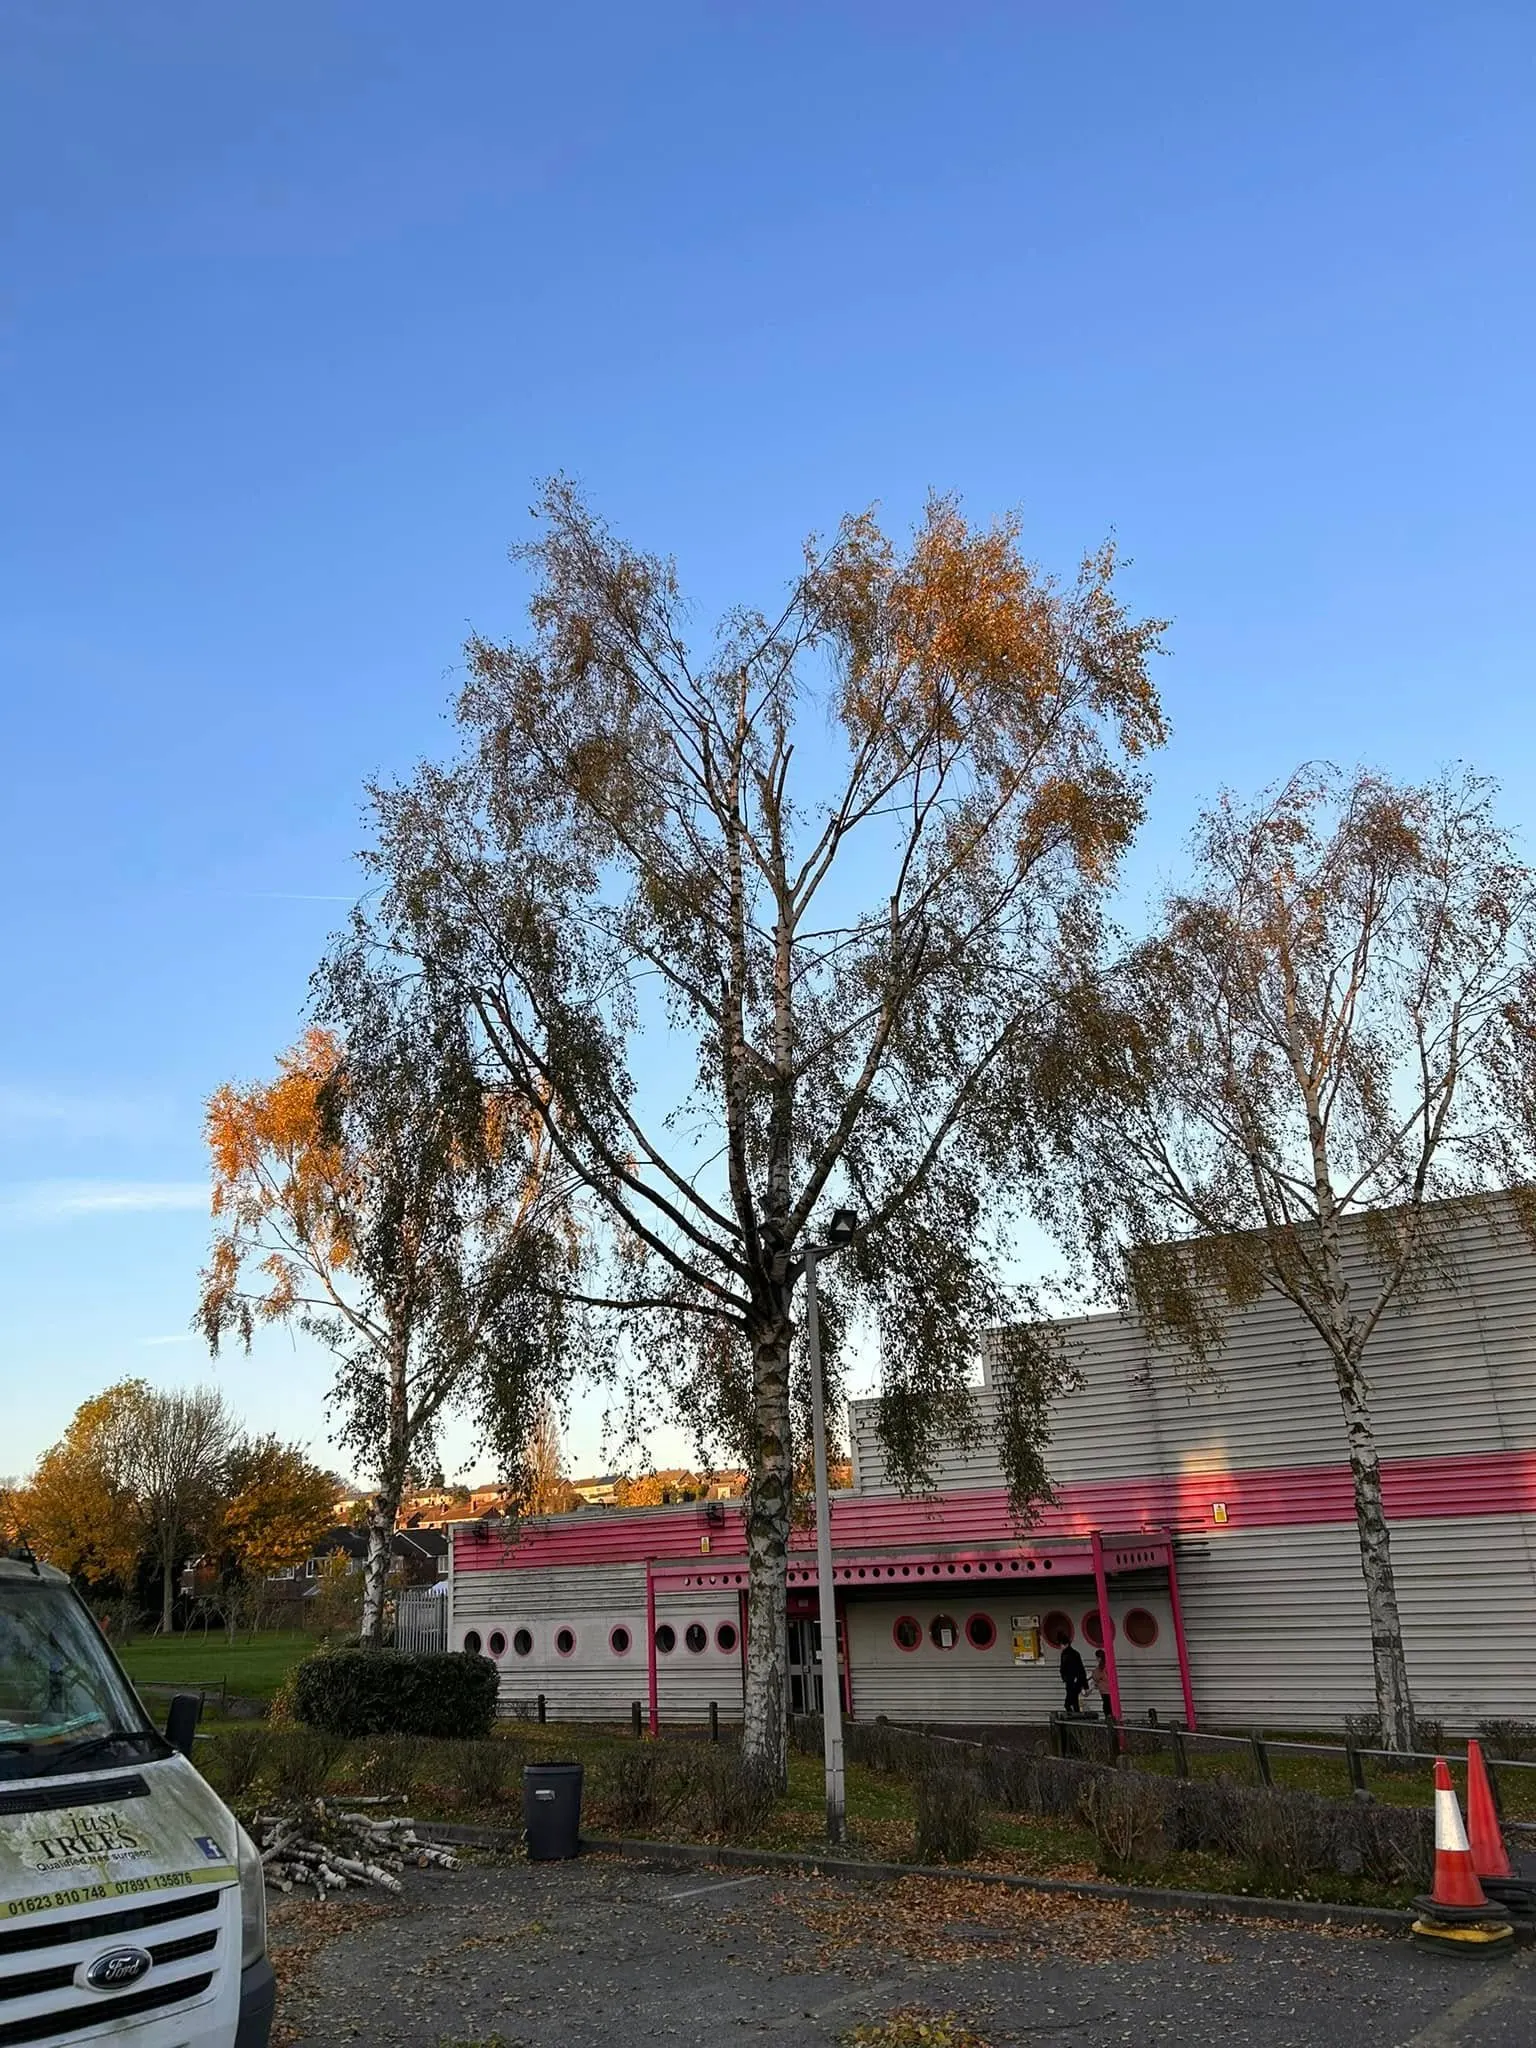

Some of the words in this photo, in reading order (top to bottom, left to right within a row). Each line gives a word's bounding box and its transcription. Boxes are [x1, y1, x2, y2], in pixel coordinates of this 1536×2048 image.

[67, 1812, 121, 1840] just
[32, 1829, 138, 1859] TREES
[36, 1856, 87, 1871] Qualified
[111, 1848, 153, 1861] surgeon
[8, 1896, 51, 1916] 01623
[56, 1890, 80, 1906] 810
[84, 1886, 107, 1901] 748
[115, 1877, 152, 1895] 07891
[153, 1872, 193, 1889] 135876
[105, 1956, 140, 1980] Ford
